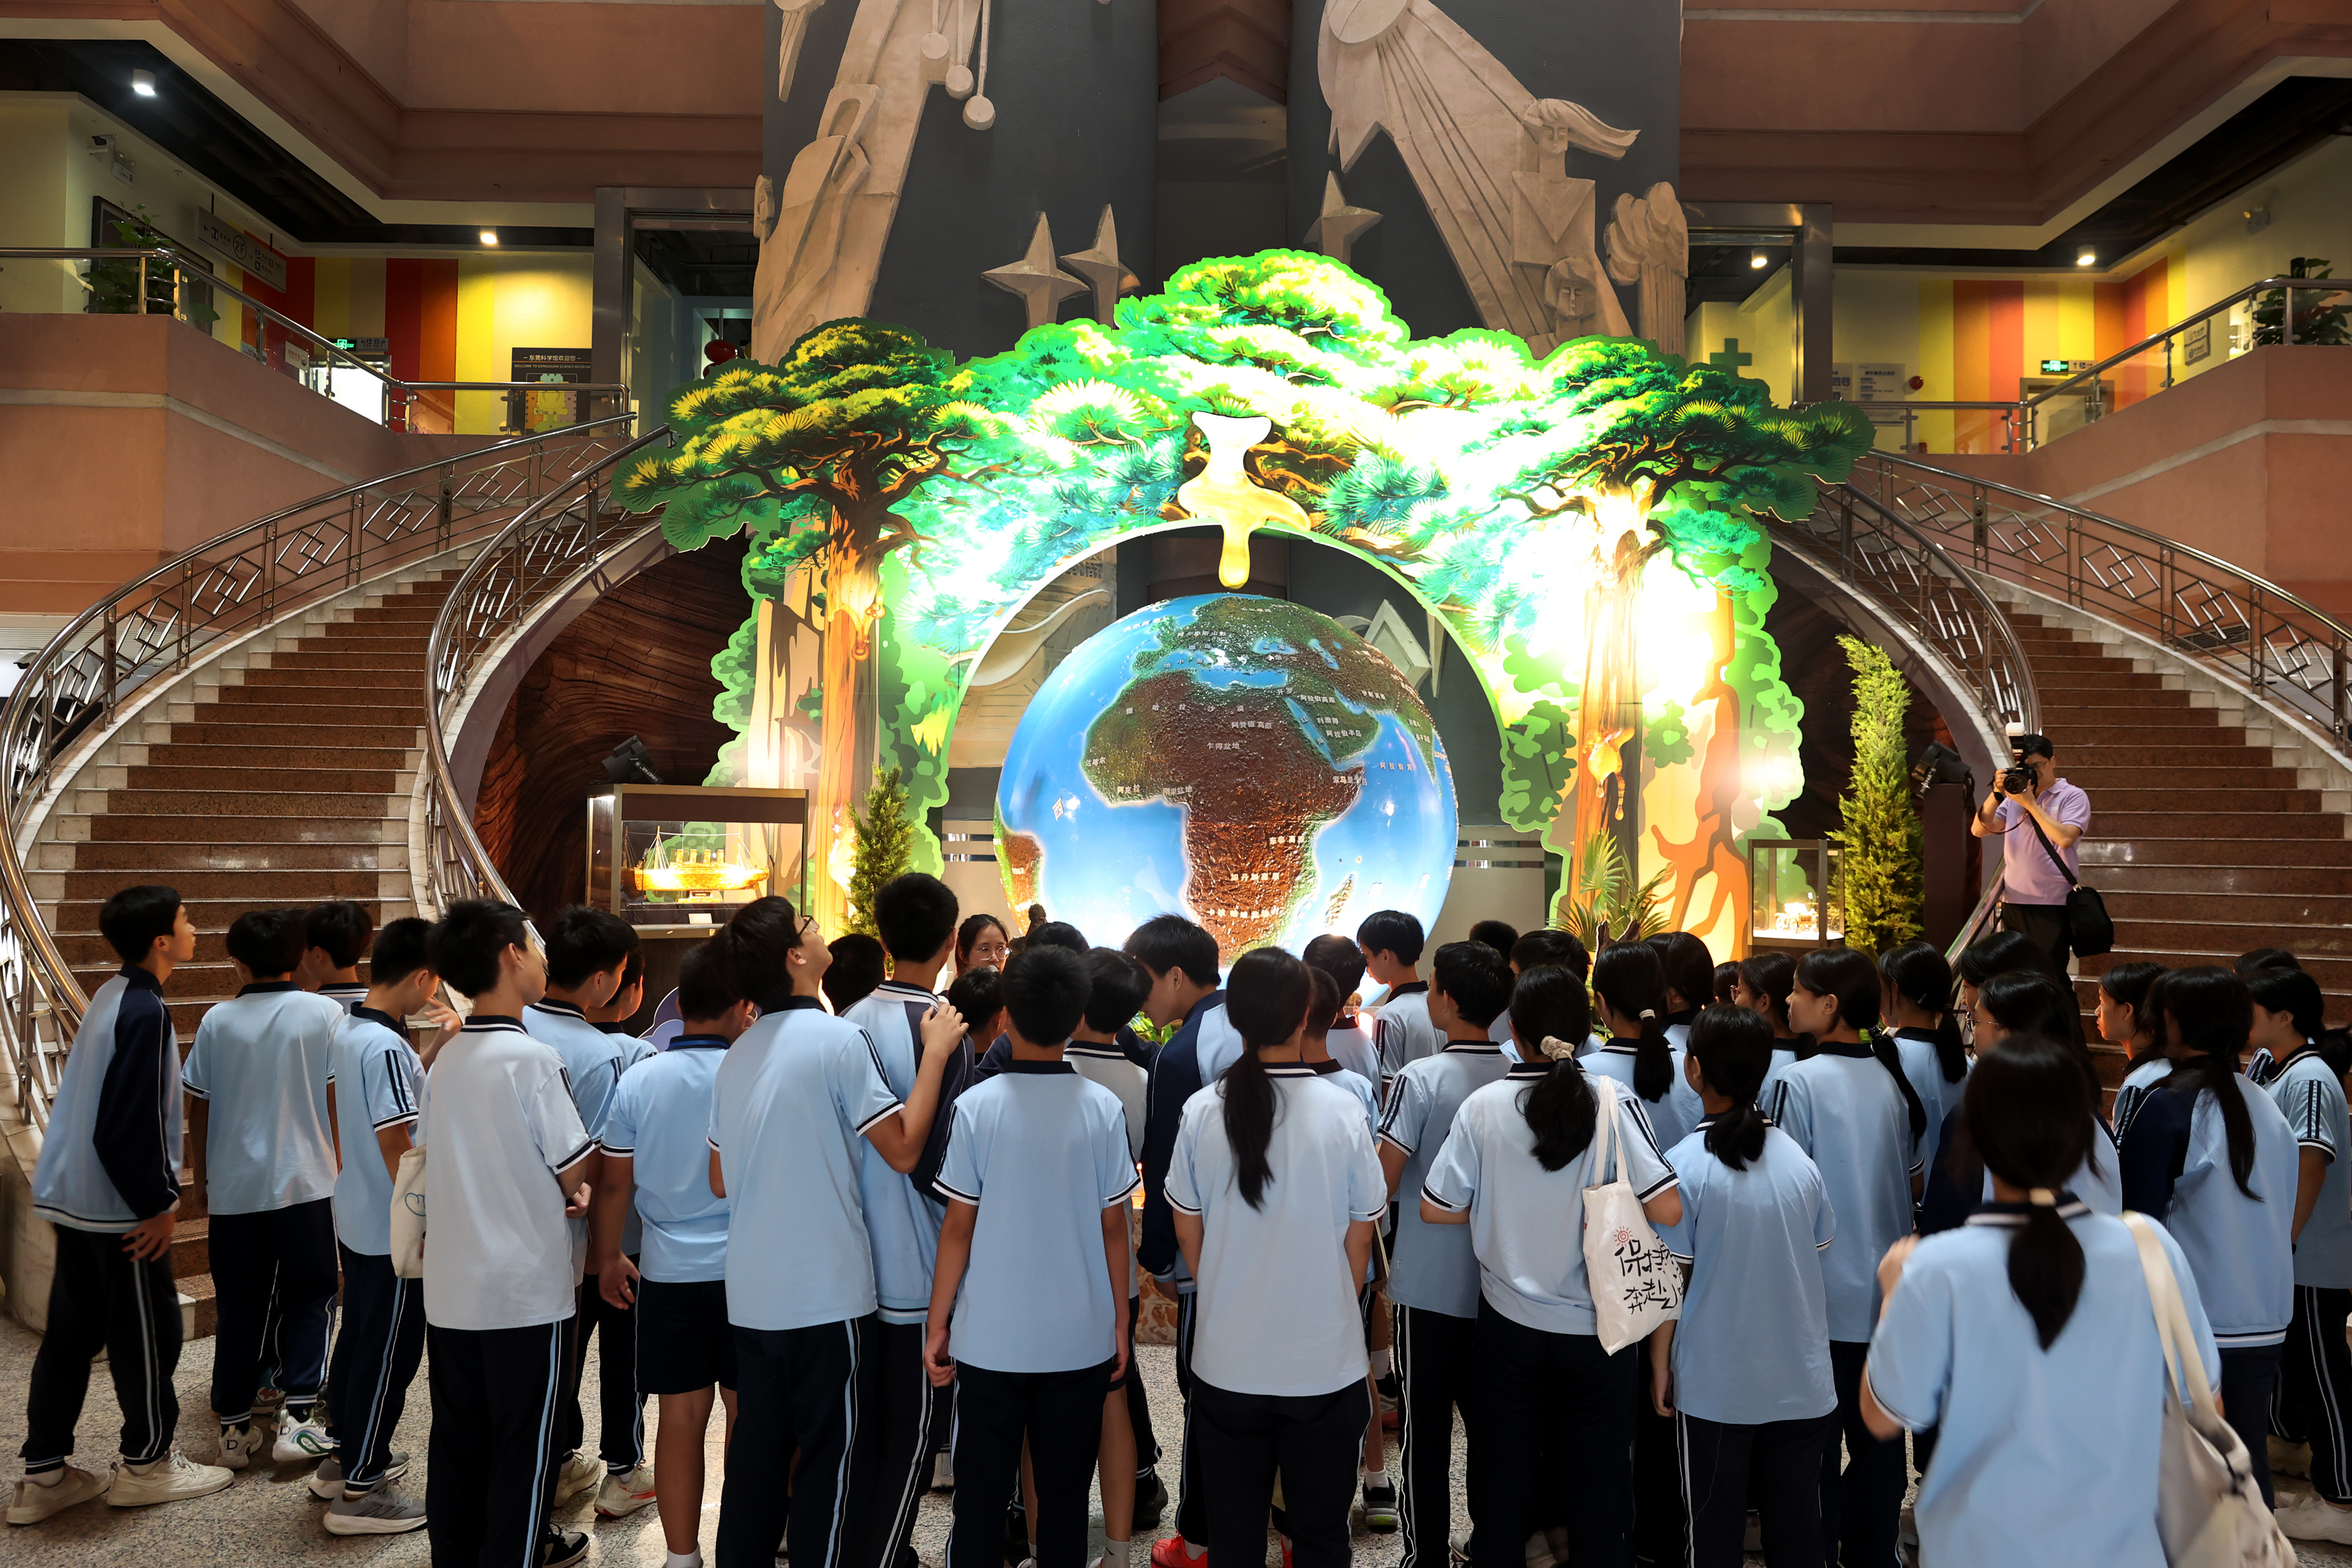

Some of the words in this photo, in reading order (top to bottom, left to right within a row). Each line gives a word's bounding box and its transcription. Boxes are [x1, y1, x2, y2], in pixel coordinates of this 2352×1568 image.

[235, 240, 245, 254] 2F
[1163, 657, 1204, 669] 地中海
[1277, 687, 1293, 696] 开罗
[1300, 694, 1336, 704] 阿拉伯高原
[1317, 716, 1339, 725] 利雅得
[1207, 742, 1240, 751] 乍得盆地
[1379, 762, 1413, 771] 阿拉伯海
[1117, 784, 1141, 794] 阿克拉
